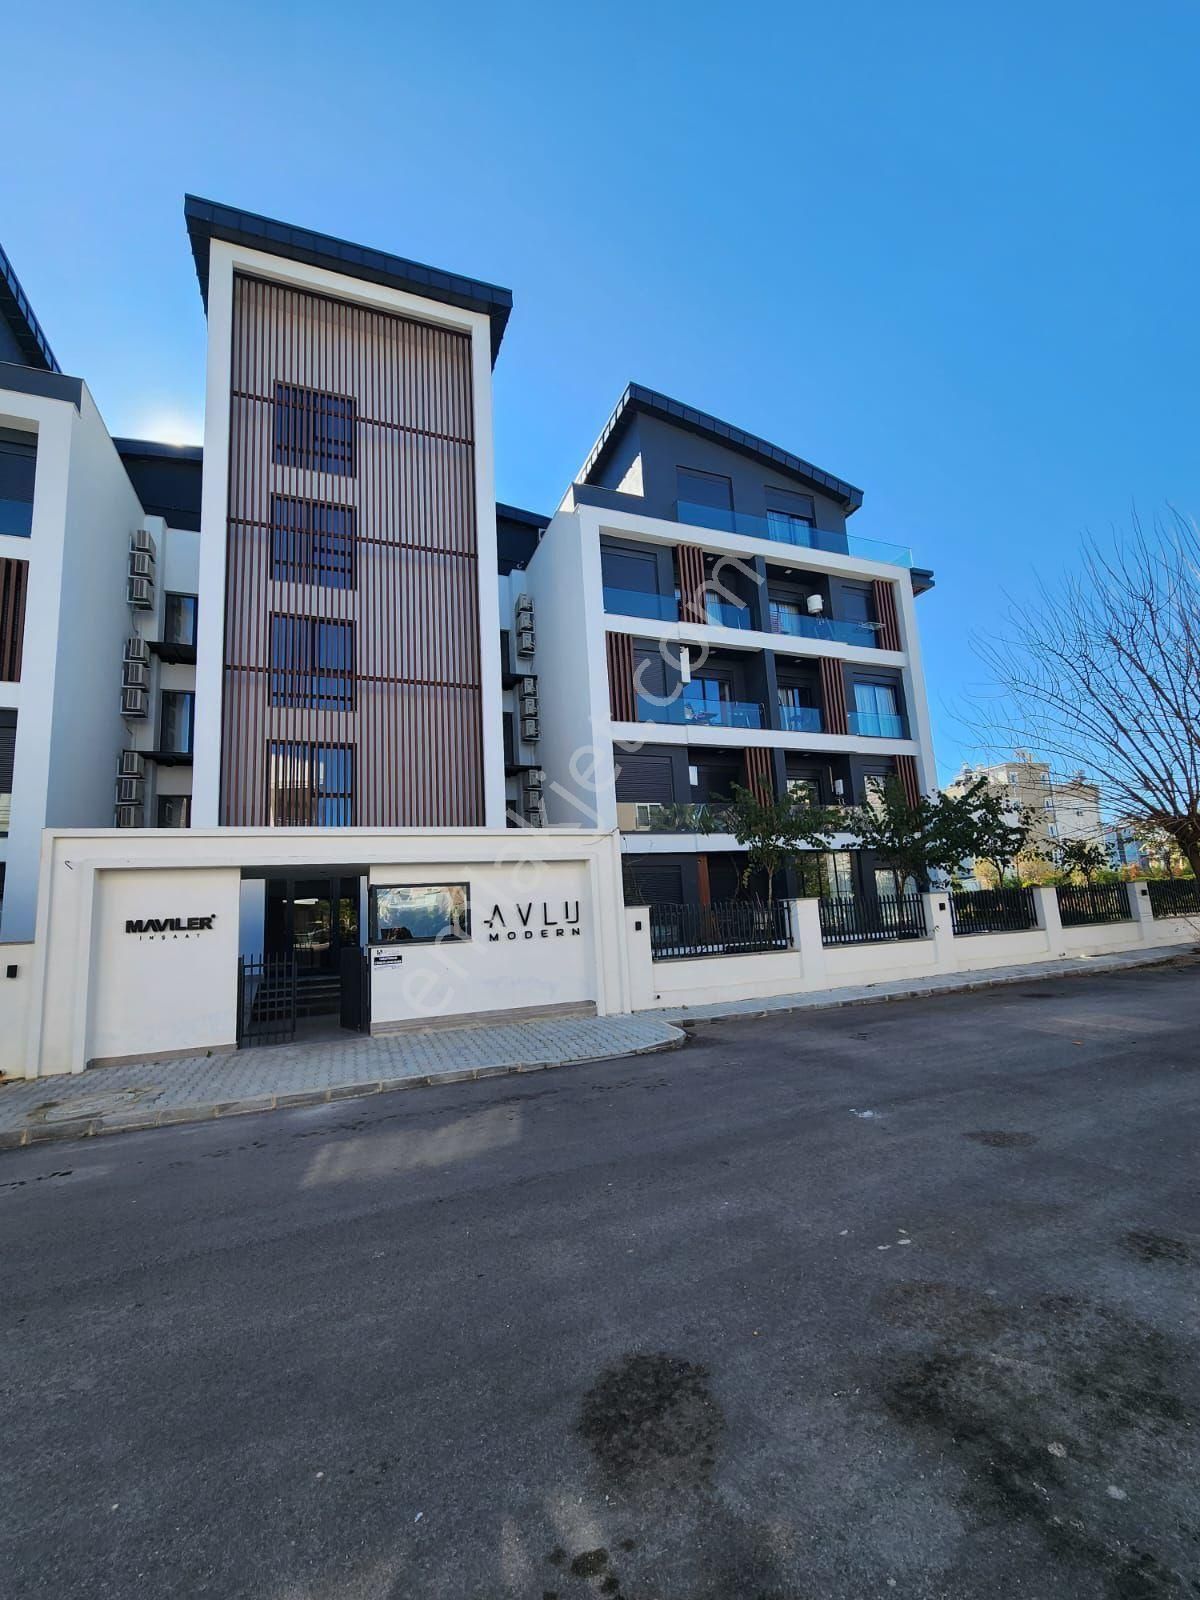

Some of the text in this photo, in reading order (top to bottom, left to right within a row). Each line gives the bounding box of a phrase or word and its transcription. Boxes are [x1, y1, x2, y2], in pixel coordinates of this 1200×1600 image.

[125, 914, 217, 934] MAVILER
[483, 900, 580, 929] AVLU
[489, 927, 581, 942] MODERN
